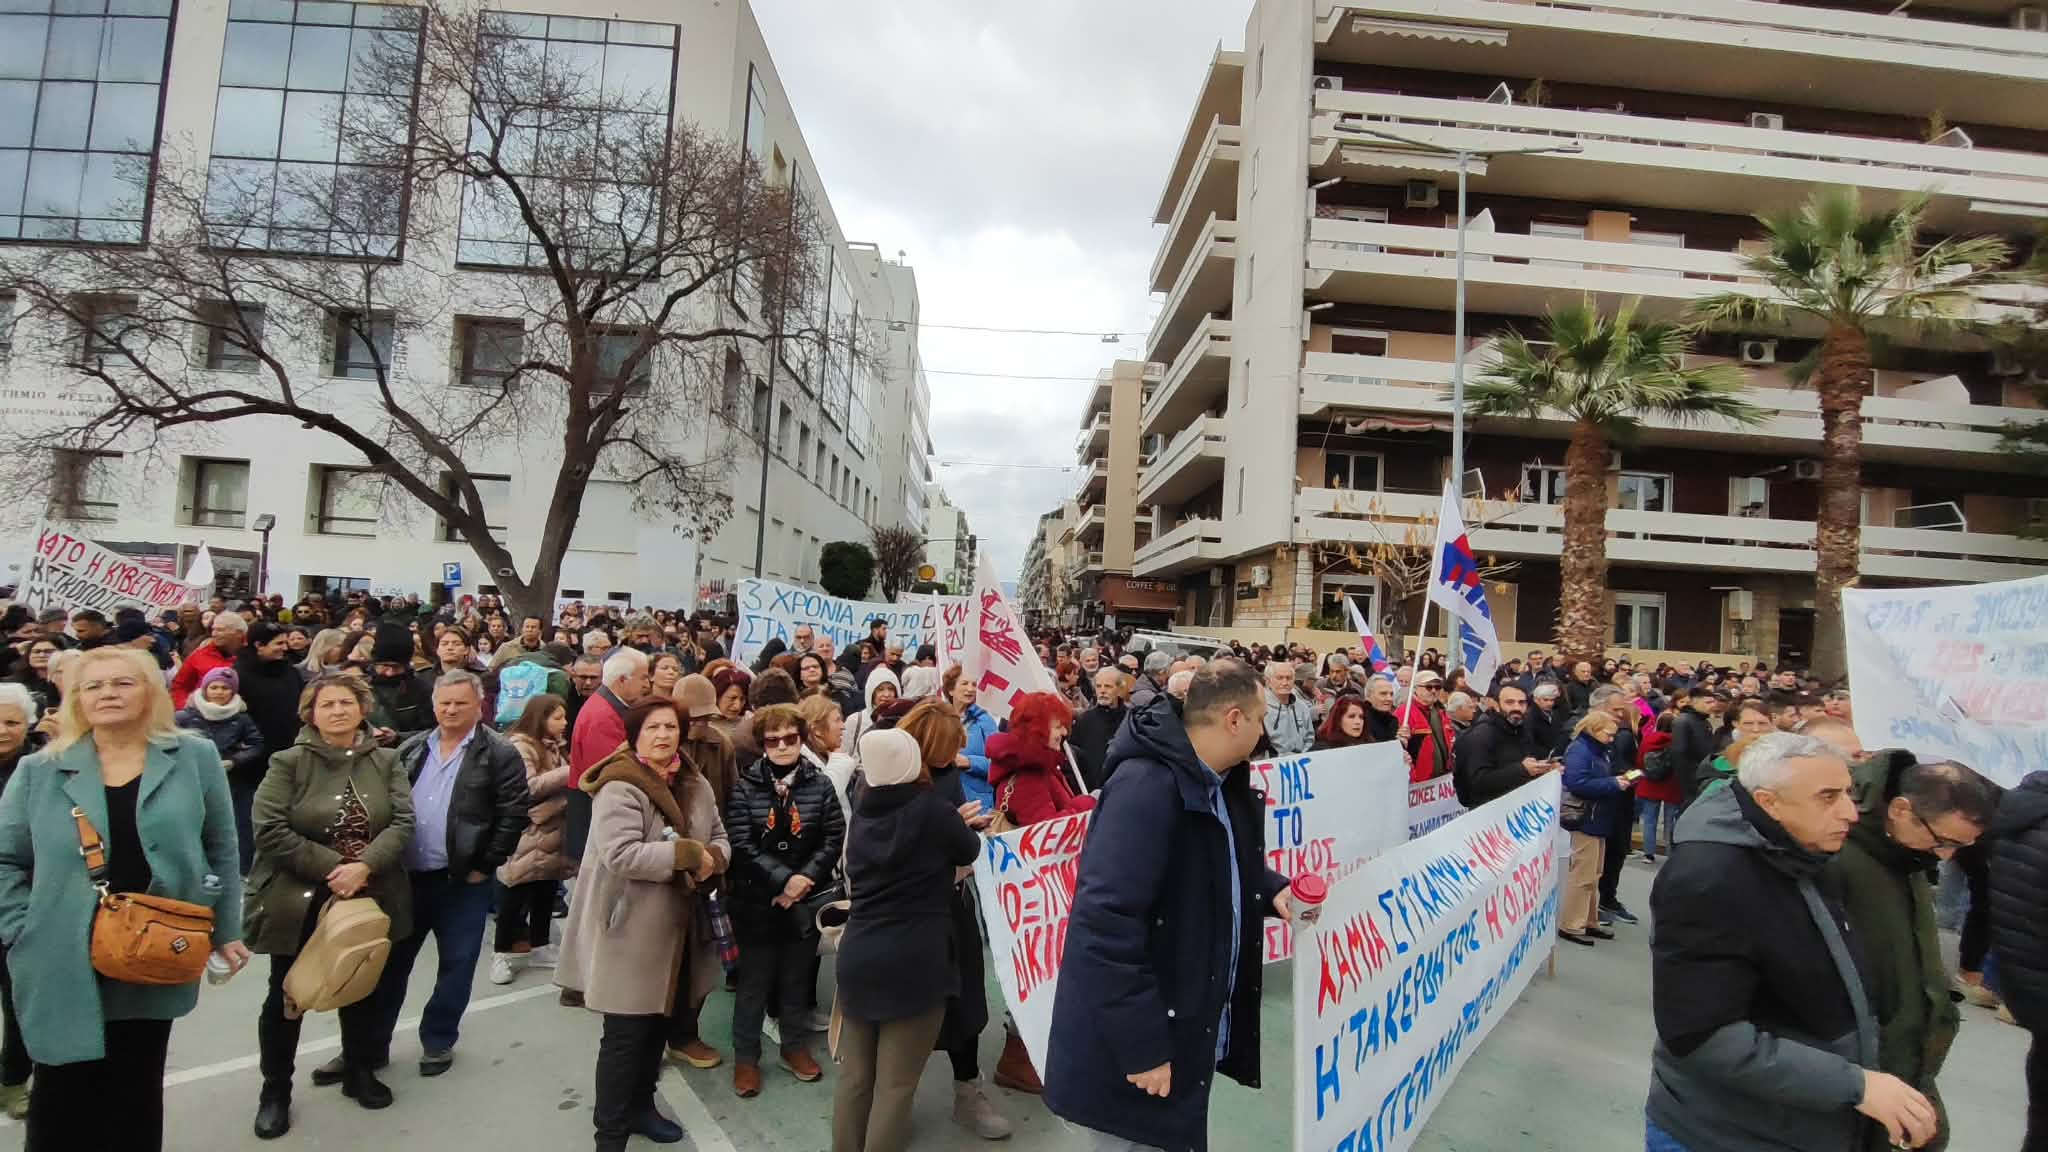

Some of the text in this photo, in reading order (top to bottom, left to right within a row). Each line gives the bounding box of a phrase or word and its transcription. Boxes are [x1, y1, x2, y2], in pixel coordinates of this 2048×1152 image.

[743, 579, 761, 611] 3
[769, 585, 854, 625] ΧΡΟΝΙΑ
[901, 613, 920, 630] ΤΟ
[743, 614, 789, 643] ΣΤΑ
[1019, 813, 1088, 863] ΚΕΡΔ
[1279, 757, 1314, 805] ΜΑΣ
[1273, 806, 1303, 848] ΤΟ
[1265, 838, 1340, 878] ΤΙΚΟΣ
[1315, 909, 1392, 1019] ΚΑΜΙΑ
